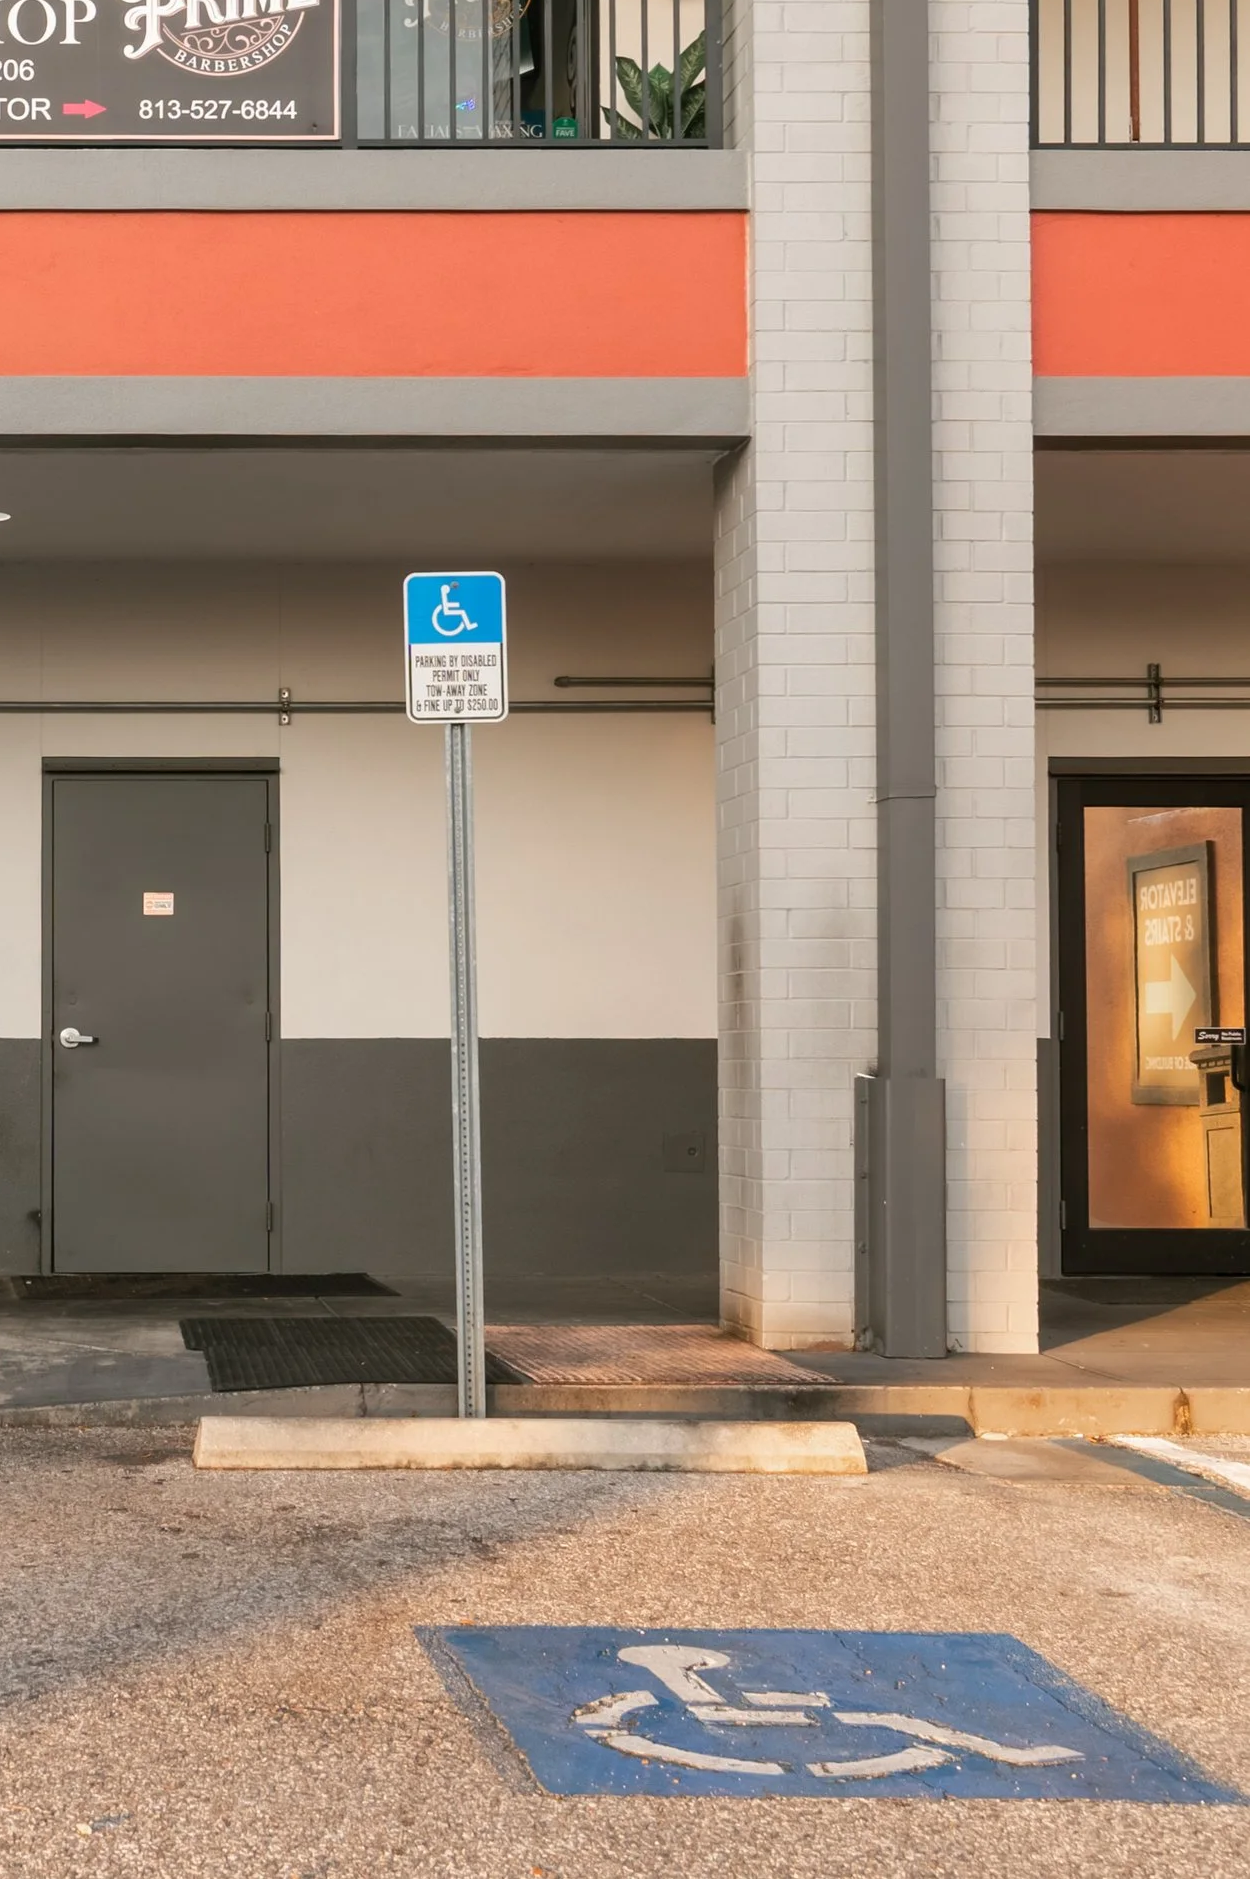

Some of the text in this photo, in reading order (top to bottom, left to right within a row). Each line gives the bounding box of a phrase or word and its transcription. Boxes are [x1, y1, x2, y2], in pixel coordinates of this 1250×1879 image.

[173, 23, 292, 73] BARBERSHOP
[138, 99, 298, 120] 813-527-6844
[474, 125, 543, 138] WAXNG
[556, 129, 575, 137] FAVE
[415, 654, 497, 668] PARKING BY DISABLED
[432, 669, 480, 682] PERMIT ONLY
[426, 684, 488, 697] TOW-AWAY ZONE
[416, 698, 499, 712] & FINE UP TO $250.00
[1198, 1031, 1219, 1041] Sorry
